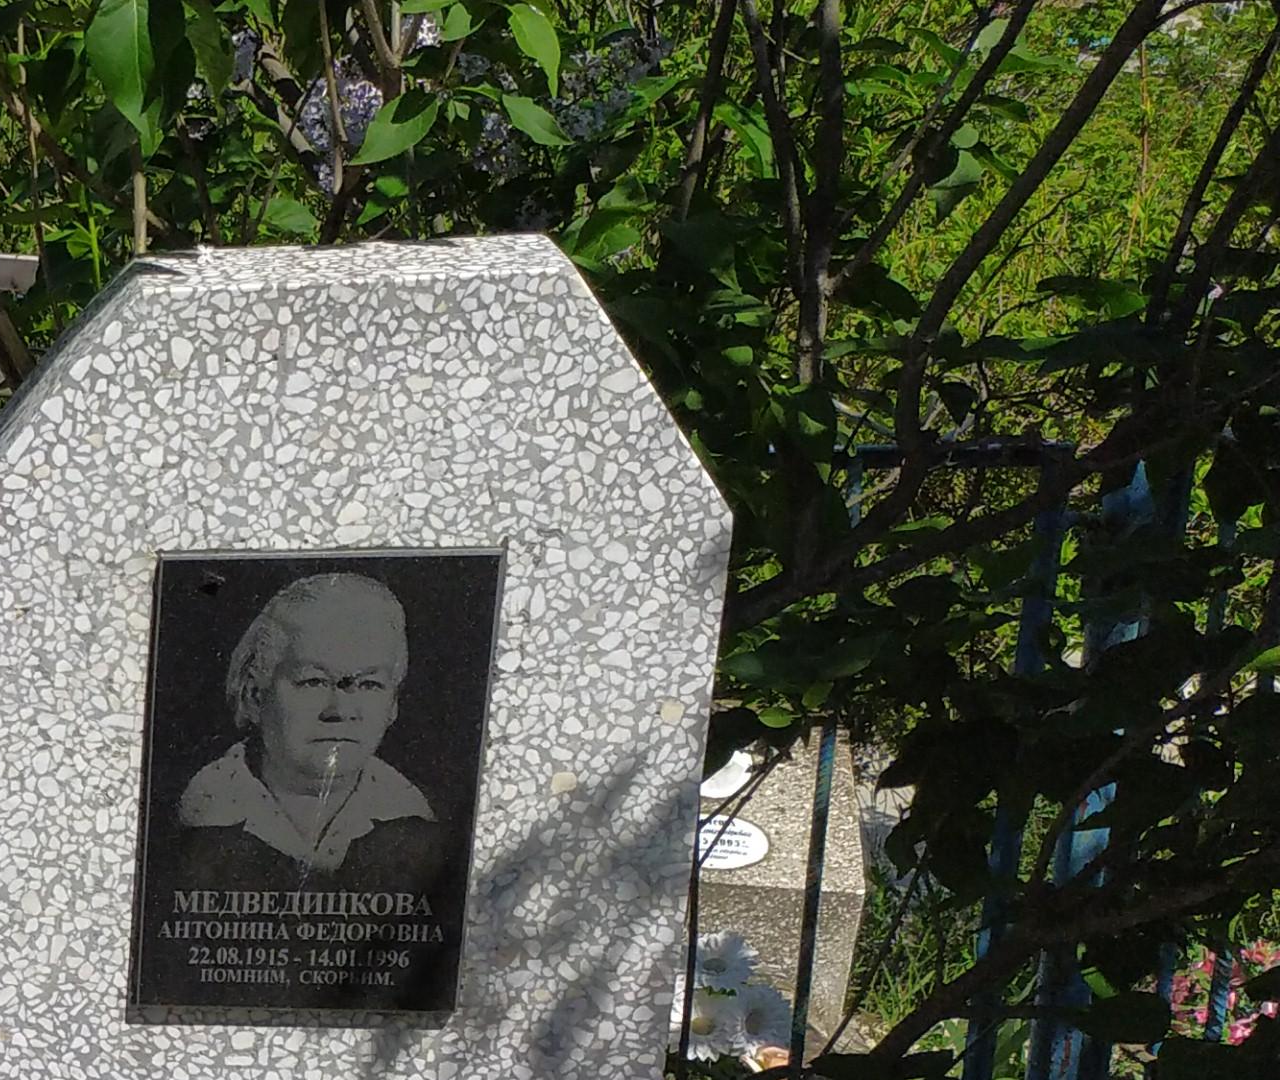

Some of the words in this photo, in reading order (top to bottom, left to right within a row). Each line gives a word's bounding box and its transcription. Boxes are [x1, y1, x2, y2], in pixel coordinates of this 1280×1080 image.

[173, 890, 433, 921] МЕДВЕДИЦКОВА
[158, 920, 289, 941] АНТОНИНА
[296, 921, 444, 944] ФЕДОРОВНА
[188, 947, 289, 967] 22.08.1915
[309, 949, 410, 968] 14.01.1996
[200, 967, 290, 987] ПОМНИМ,
